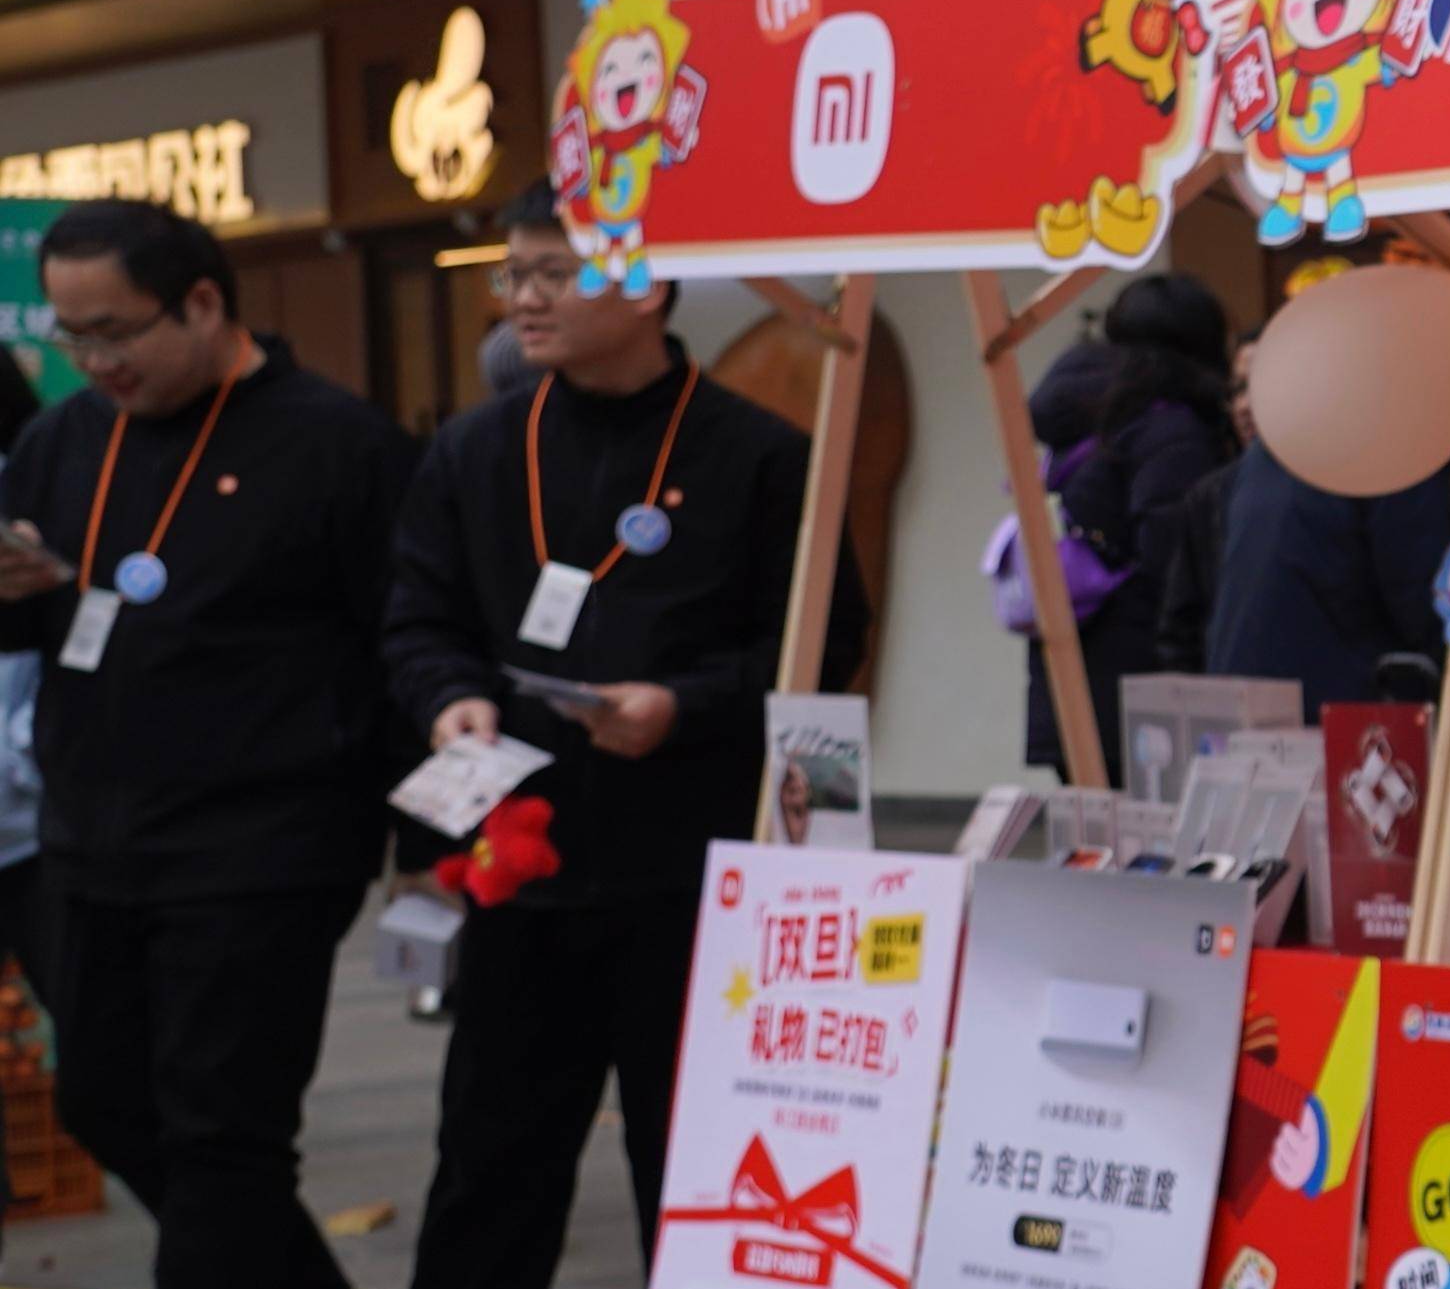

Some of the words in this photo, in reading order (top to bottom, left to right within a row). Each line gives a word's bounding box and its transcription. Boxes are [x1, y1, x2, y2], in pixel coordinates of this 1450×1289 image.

[967, 1139, 1044, 1194] 为冬日
[1050, 1153, 1179, 1217] 定义新温度
